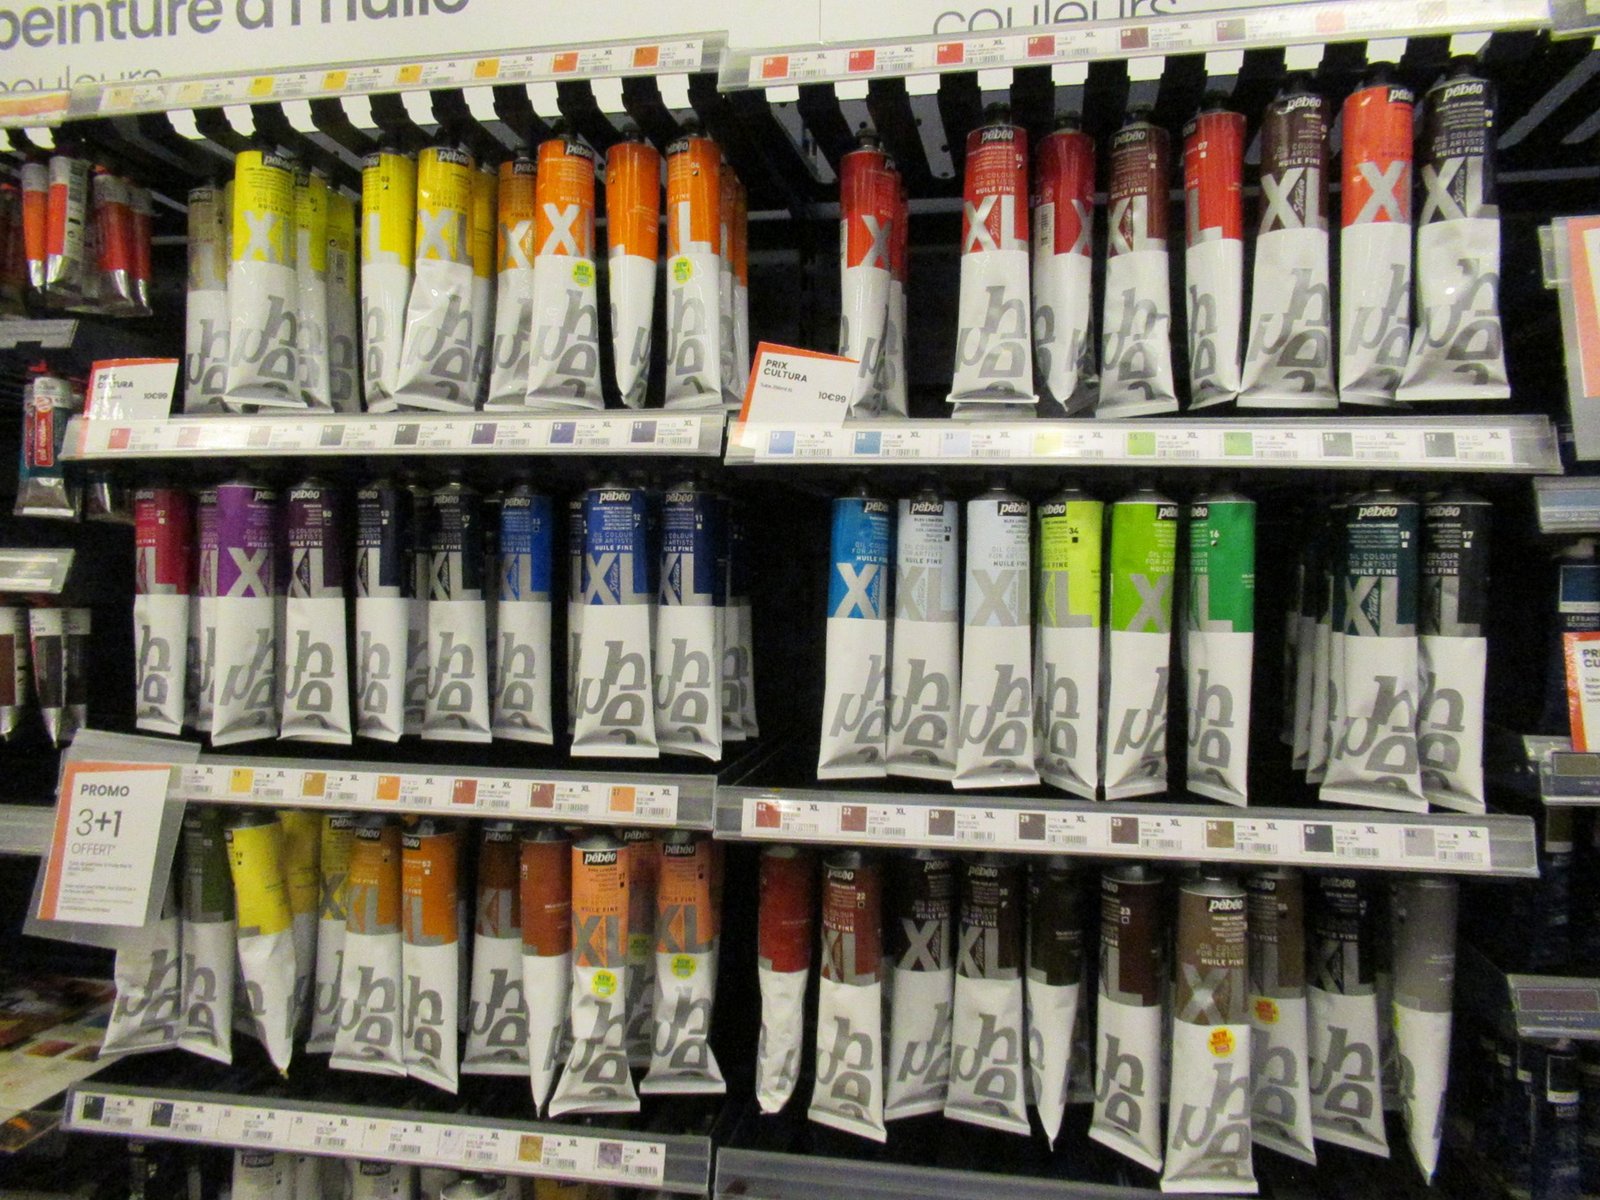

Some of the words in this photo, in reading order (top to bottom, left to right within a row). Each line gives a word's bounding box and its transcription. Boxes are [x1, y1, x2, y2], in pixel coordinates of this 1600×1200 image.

[1442, 82, 1484, 101] pébéo
[1197, 142, 1209, 151] 07
[1435, 148, 1462, 159] HUILE
[1463, 145, 1485, 155] FINE
[1356, 161, 1411, 225] X
[1419, 156, 1500, 227] XL
[1259, 167, 1329, 233] XL
[962, 195, 1029, 252] XL
[765, 358, 789, 370] PRIX
[763, 367, 808, 383] CULTURA
[817, 391, 847, 403] 10€99
[1187, 431, 1199, 439] XL
[1284, 431, 1296, 439] XL
[1488, 431, 1501, 439] XL
[598, 491, 632, 504] pébéo
[911, 501, 944, 514] pébéo
[1357, 505, 1398, 519] pébéo
[1069, 527, 1079, 535] 34
[1209, 530, 1220, 538] 16
[1462, 530, 1474, 539] 17
[306, 539, 323, 547] FINE
[1363, 552, 1398, 560] COLOUR
[1350, 567, 1375, 576] HUILE
[1376, 567, 1398, 575] FINE
[585, 553, 649, 606] XL
[658, 554, 713, 606] XL
[896, 566, 958, 623] XL
[1128, 574, 1174, 632] X
[1344, 576, 1416, 637] XL
[350, 774, 359, 782] XL
[502, 781, 512, 789] XL
[581, 784, 590, 792] XL
[81, 784, 130, 798] PROMO
[662, 788, 672, 796] XL
[809, 803, 819, 812] XL
[896, 807, 906, 816] XL
[984, 810, 995, 819] XL
[1076, 814, 1087, 824] XL
[76, 808, 123, 838] 3+1
[1169, 818, 1182, 828] XL
[1266, 821, 1278, 832] XL
[1365, 825, 1378, 835] XL
[1467, 829, 1481, 840] XL
[584, 850, 618, 864] pébéo
[1208, 899, 1243, 912] pébéo
[957, 928, 1019, 979] XL
[491, 1131, 500, 1141] XL
[568, 1138, 578, 1147] XL
[649, 1145, 659, 1155] XL
